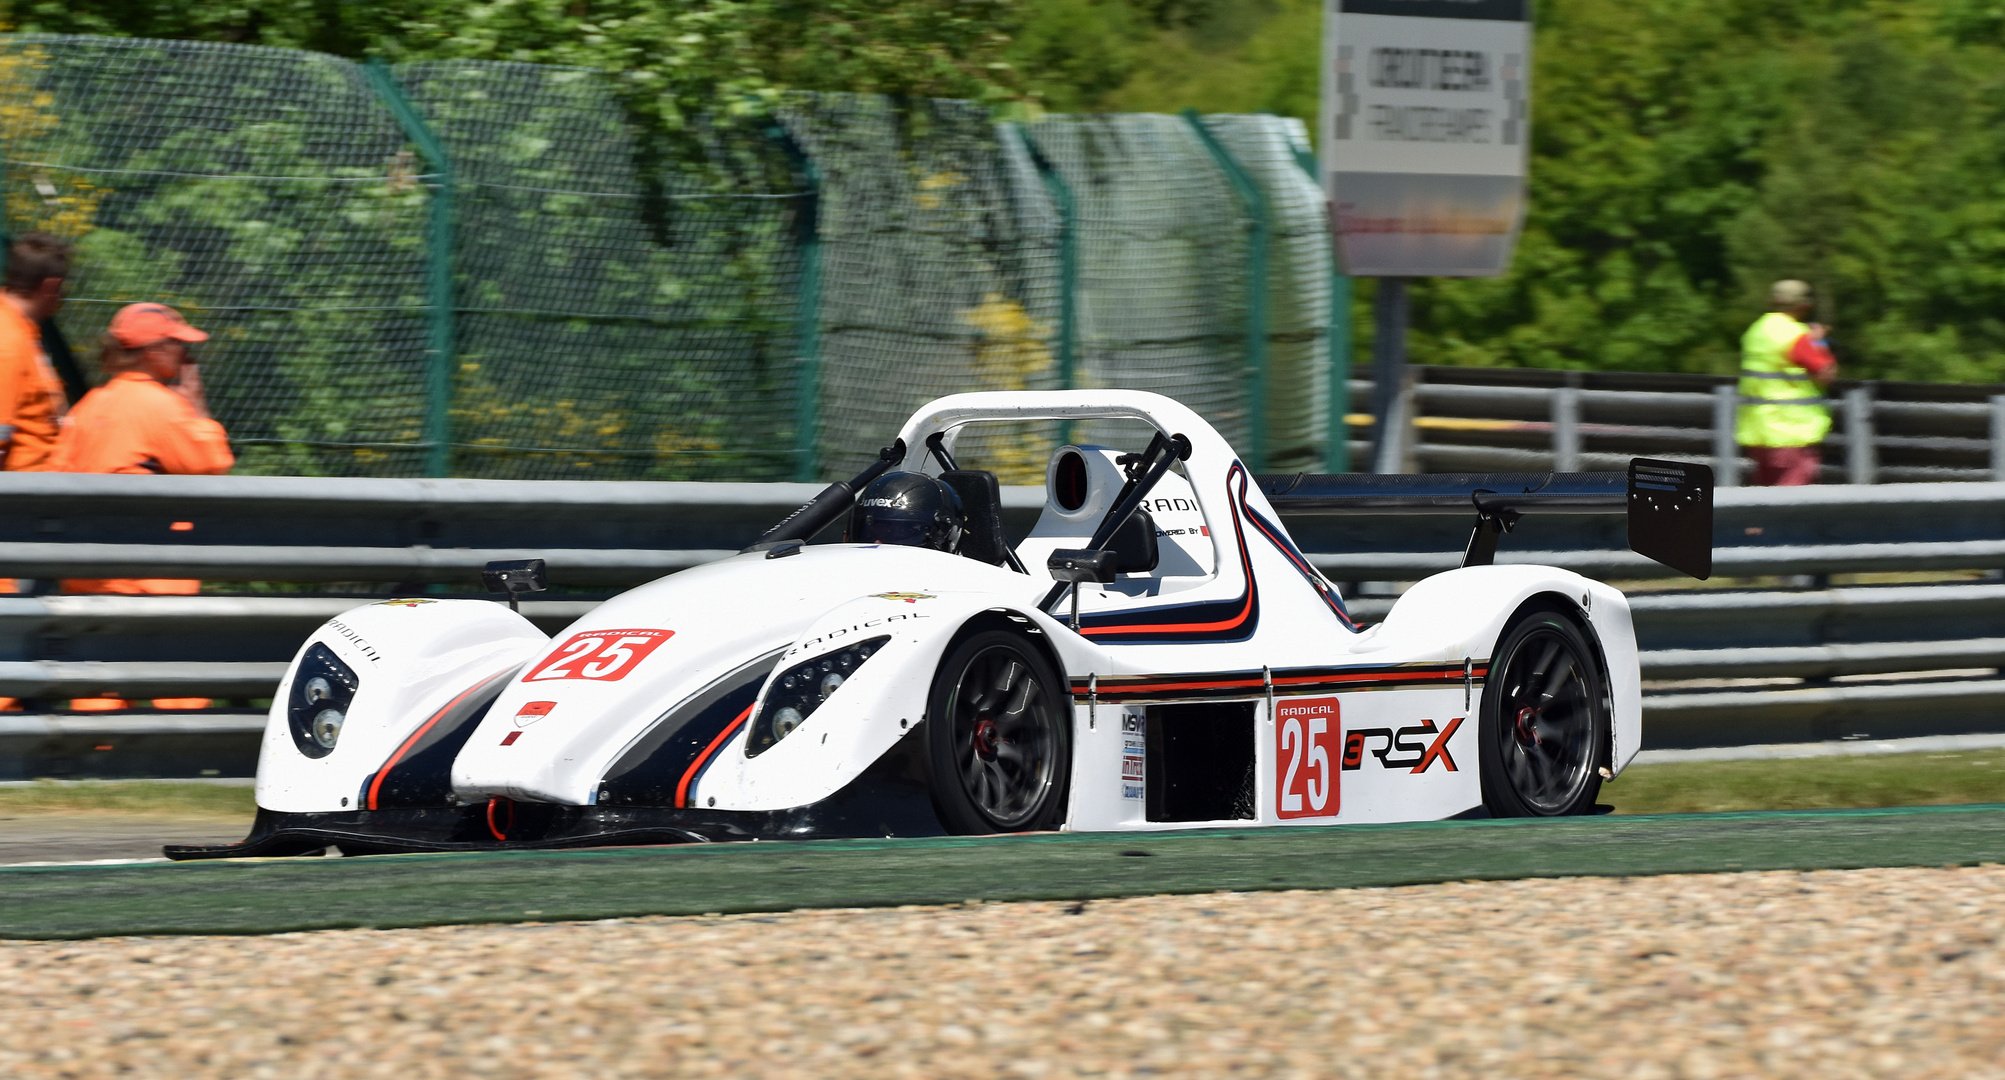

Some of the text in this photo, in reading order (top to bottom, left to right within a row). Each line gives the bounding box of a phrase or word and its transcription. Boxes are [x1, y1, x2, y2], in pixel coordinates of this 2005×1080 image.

[863, 497, 894, 508] uvex
[1140, 498, 1198, 512] RADI
[1155, 528, 1186, 538] OWERED
[578, 630, 664, 638] RADICAL
[327, 619, 381, 669] RADICAL
[531, 636, 652, 679] 25
[1280, 705, 1335, 716] RADICAL
[1281, 717, 1330, 812] 25
